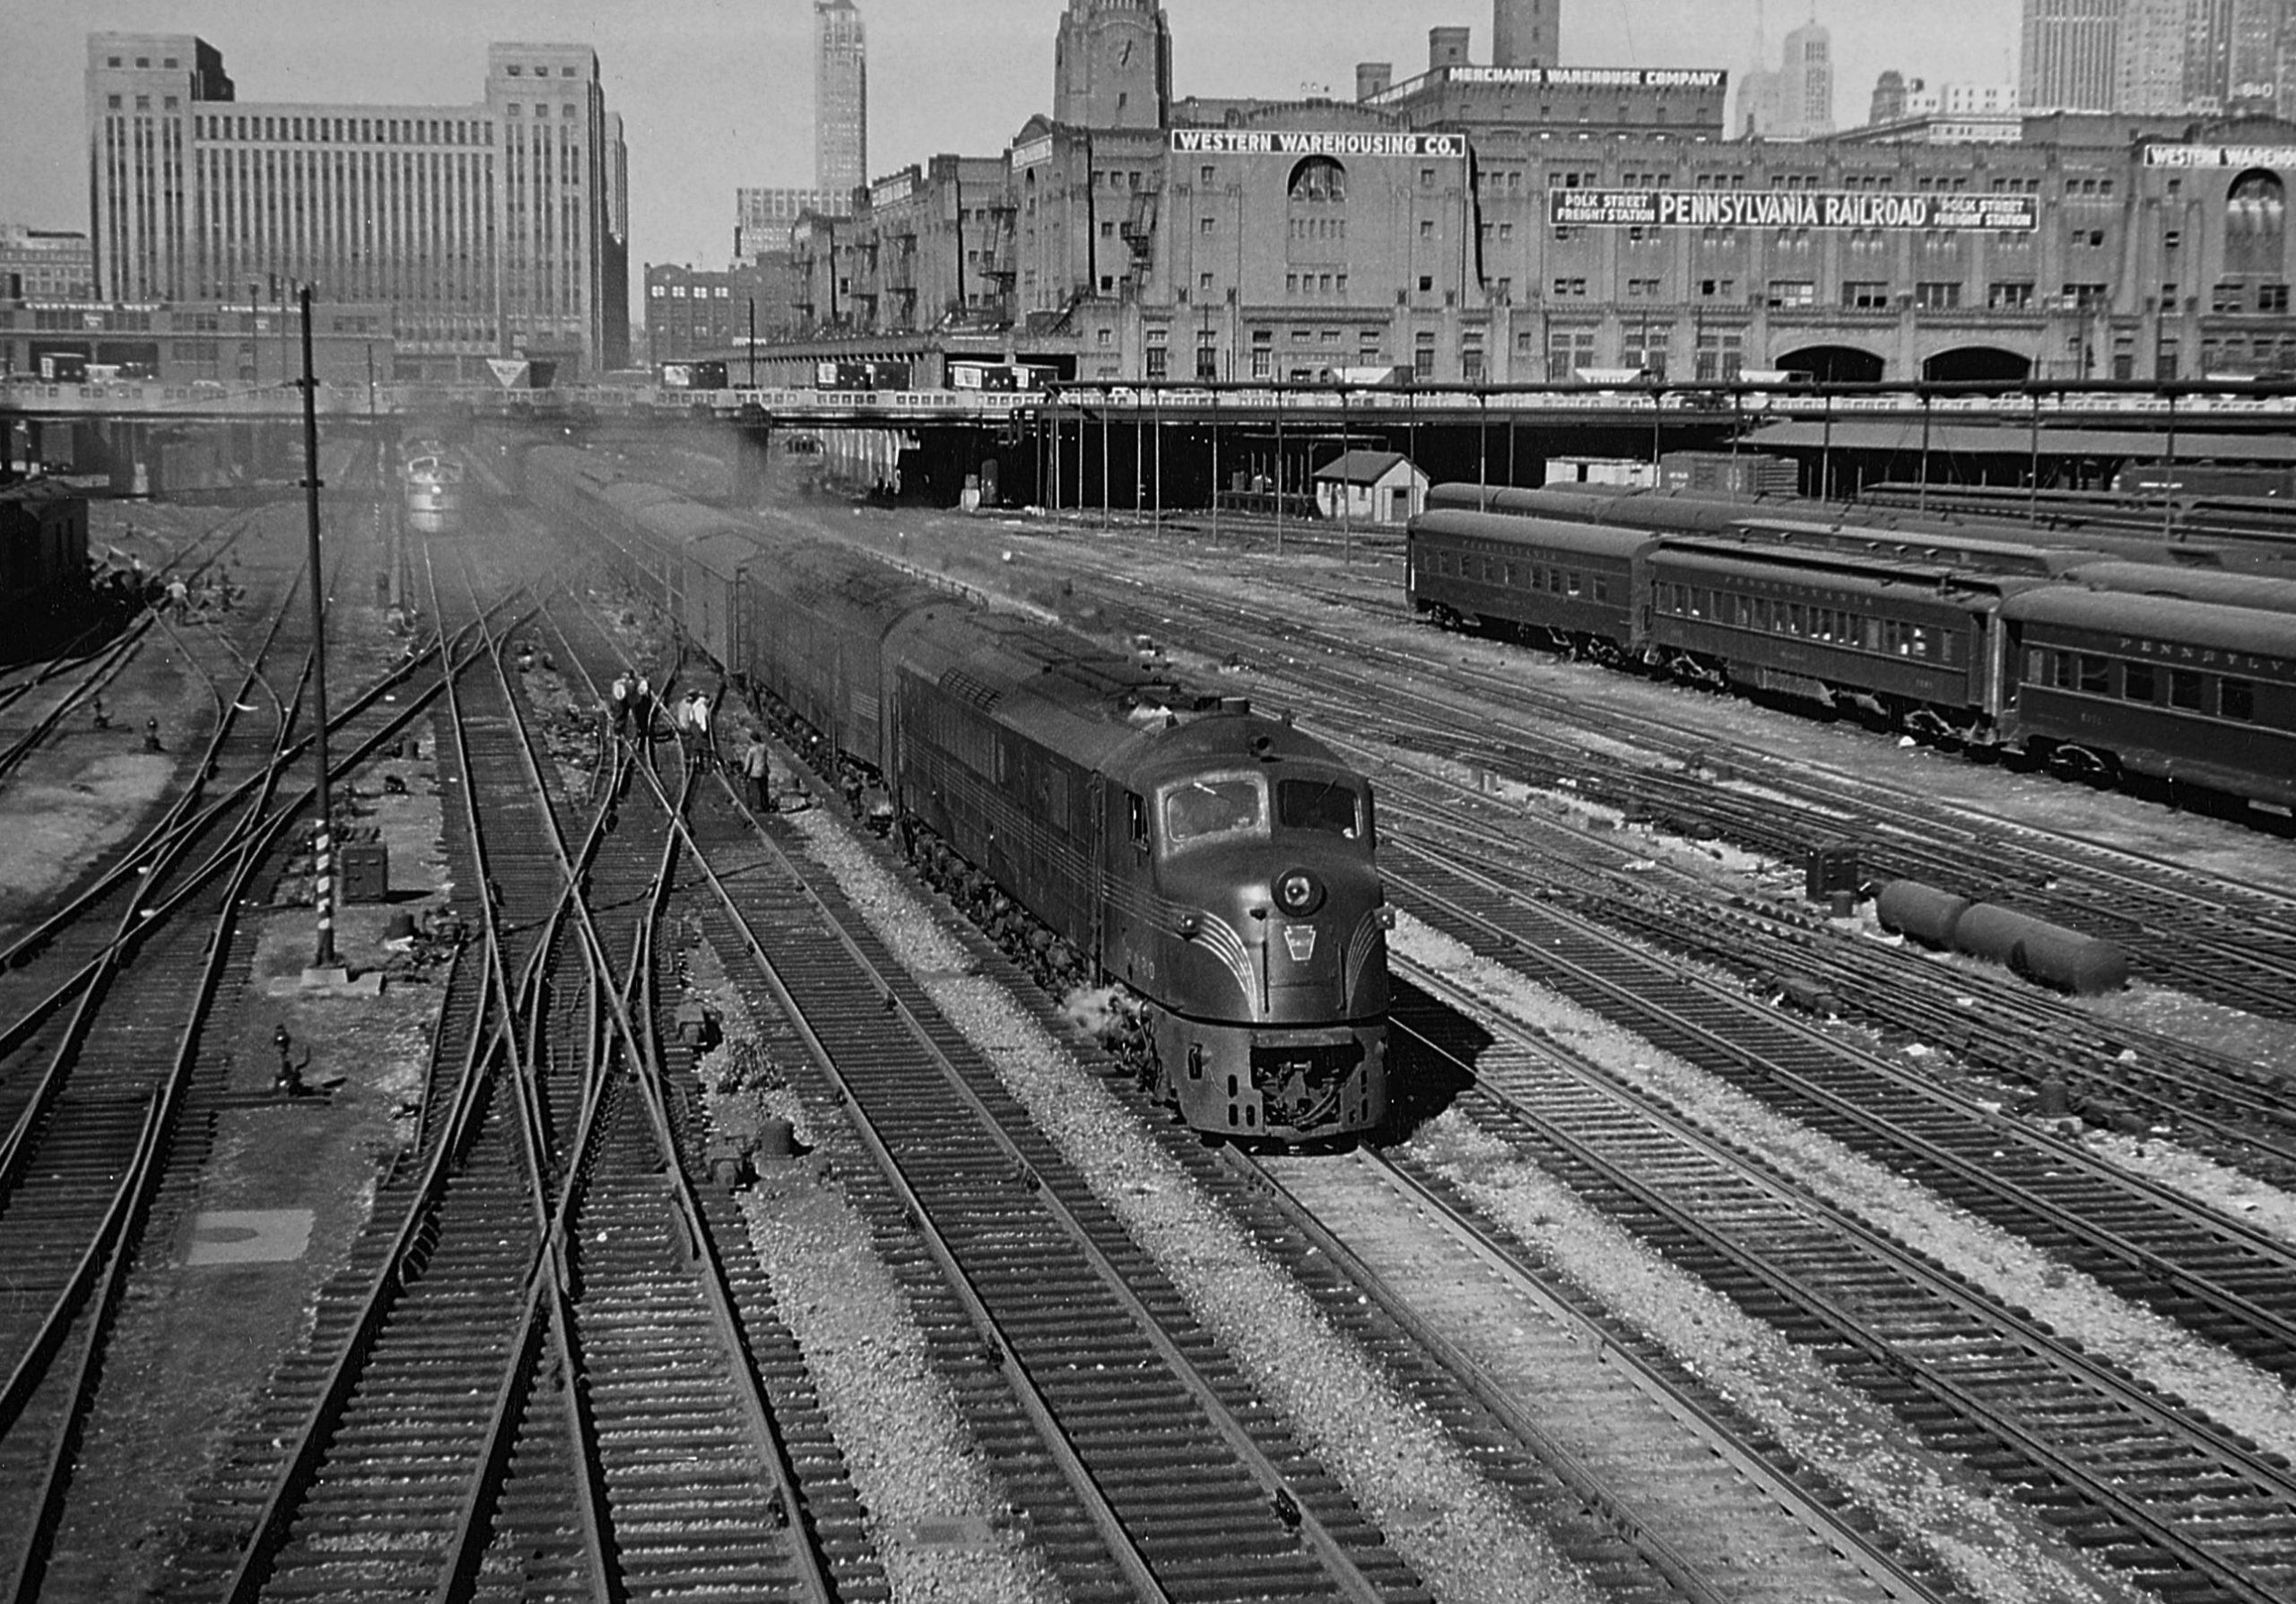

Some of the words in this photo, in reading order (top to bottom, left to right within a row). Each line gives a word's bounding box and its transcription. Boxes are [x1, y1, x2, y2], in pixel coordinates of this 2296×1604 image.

[1449, 67, 1542, 83] MERCHANTS
[1547, 69, 1641, 85] WAREHOUSE
[1646, 71, 1721, 86] COMPANY
[1179, 132, 1272, 151] WESTERN
[1278, 135, 1417, 153] WAREHOUSING
[1424, 138, 1457, 155] CO.
[1565, 195, 1597, 207] POLK
[1603, 195, 1648, 208] STREET
[1942, 200, 1977, 213] POLK
[1979, 201, 2024, 213] STREET
[1558, 208, 1606, 221] FREIGHT
[1608, 208, 1655, 222] STATION
[1660, 195, 1819, 224] PENNSYLVANIA
[1825, 196, 1926, 226] RAILROAD
[1985, 214, 2031, 226] STATION
[2120, 638, 2296, 675] PENNSYLV
